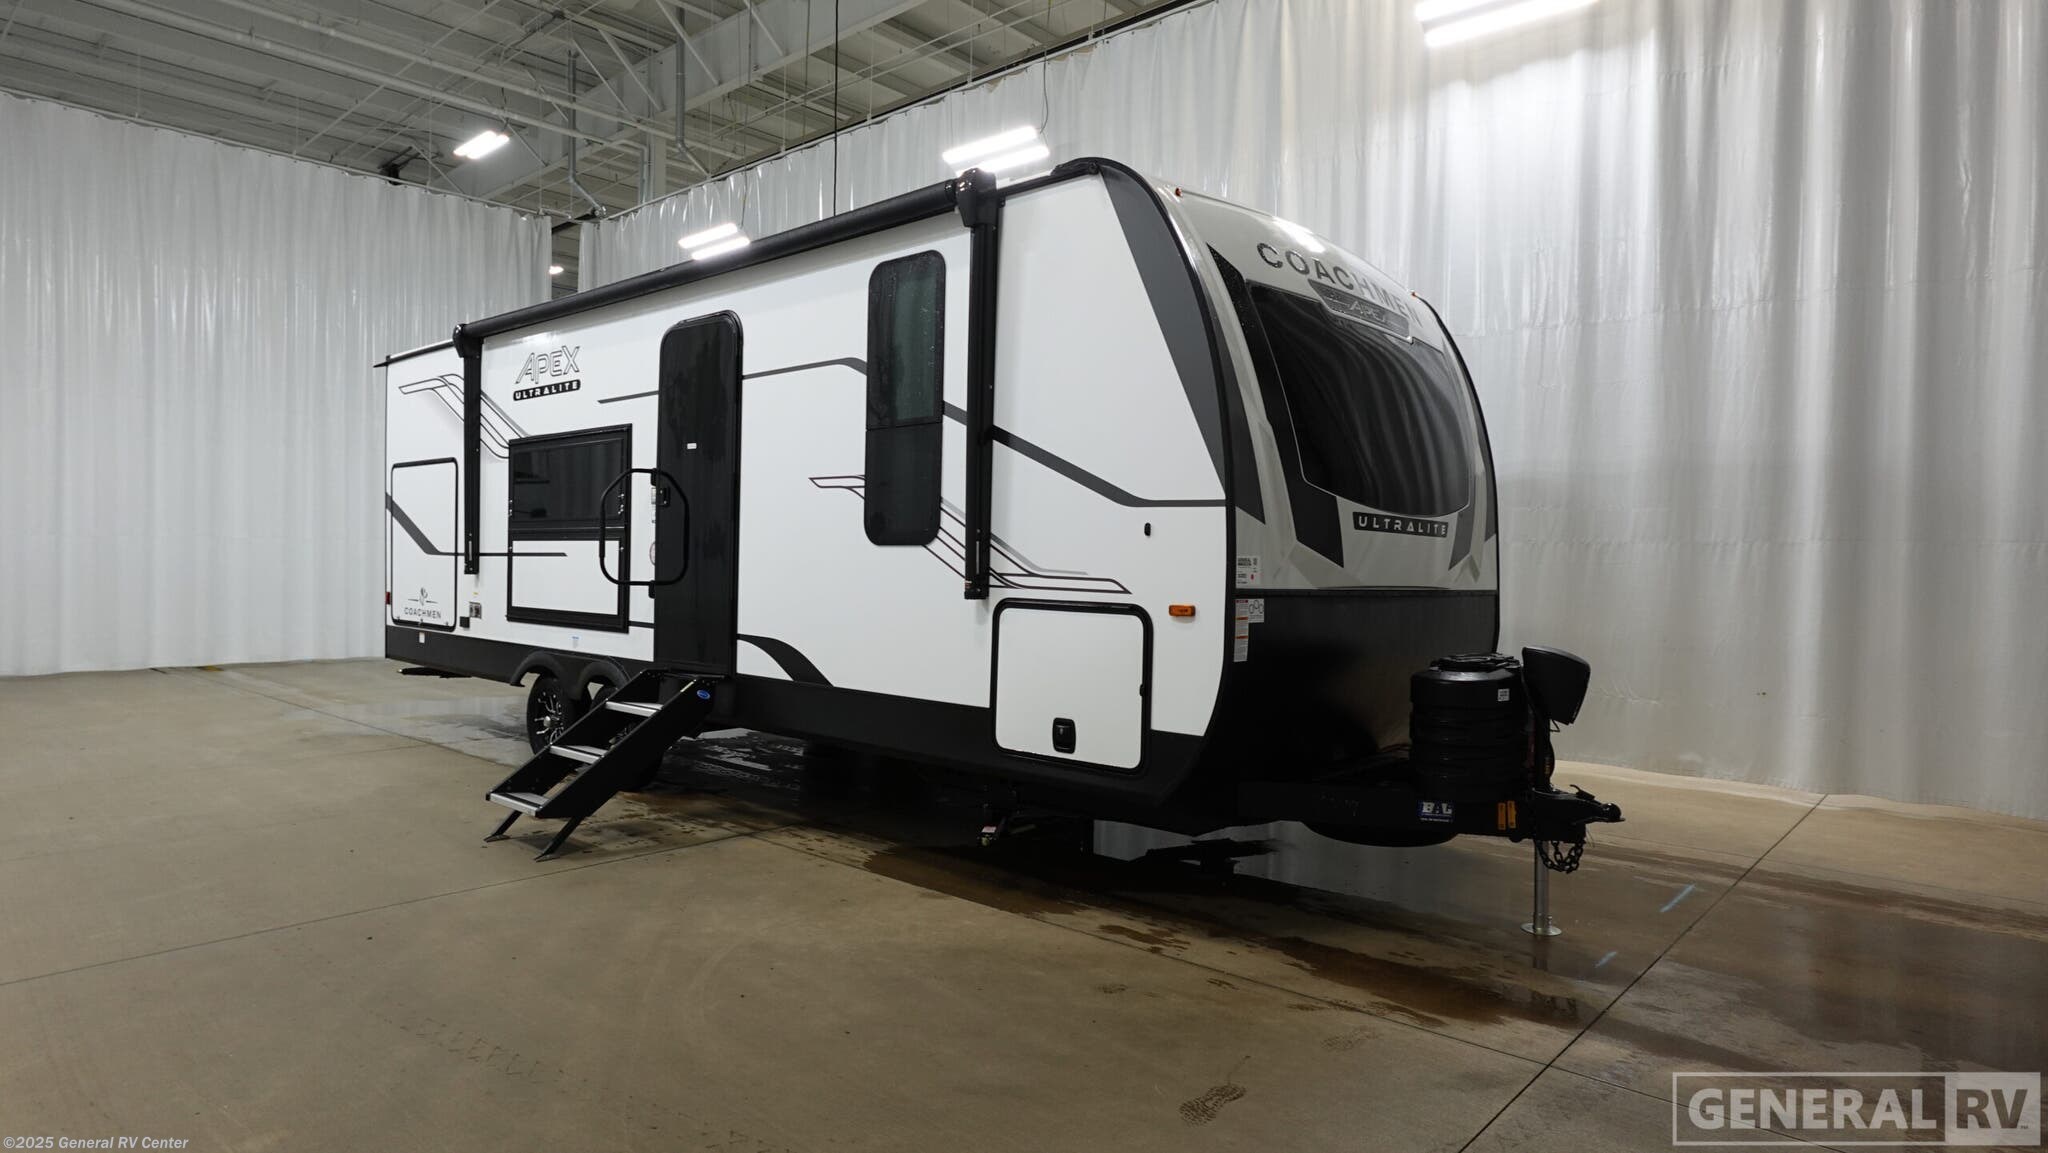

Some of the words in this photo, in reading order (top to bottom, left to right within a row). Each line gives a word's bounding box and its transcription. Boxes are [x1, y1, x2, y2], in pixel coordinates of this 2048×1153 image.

[1256, 242, 1423, 328] COACHMEN
[515, 345, 580, 385] APEX
[514, 381, 578, 400] ULTRALITE
[1358, 515, 1447, 536] ULTRALITE
[404, 607, 441, 619] COACHMEN
